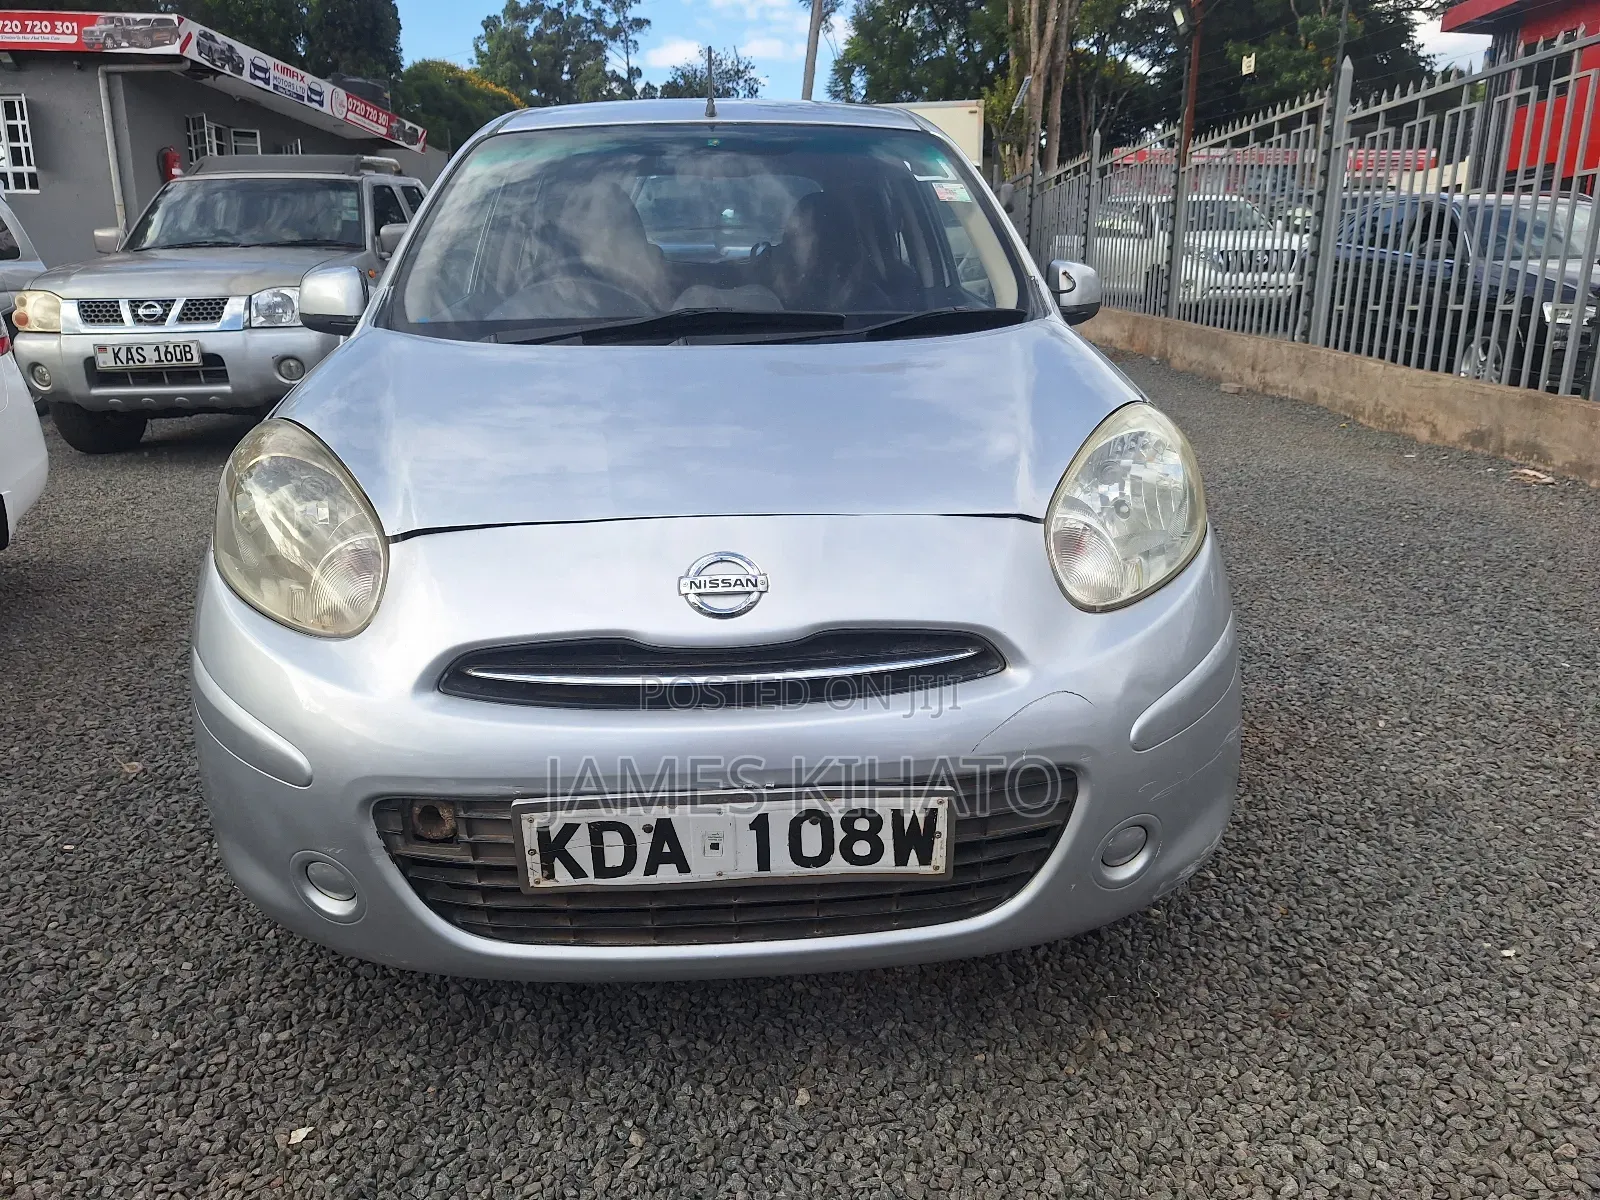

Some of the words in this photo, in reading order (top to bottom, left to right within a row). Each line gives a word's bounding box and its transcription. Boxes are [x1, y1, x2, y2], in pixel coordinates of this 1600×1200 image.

[25, 20, 51, 33] 720
[54, 21, 78, 34] 301
[347, 97, 366, 116] 0720
[365, 105, 378, 122] 720
[112, 346, 147, 365] KAS
[689, 577, 759, 590] NISSAN
[536, 817, 692, 879] KDA
[748, 807, 938, 872] 108W
